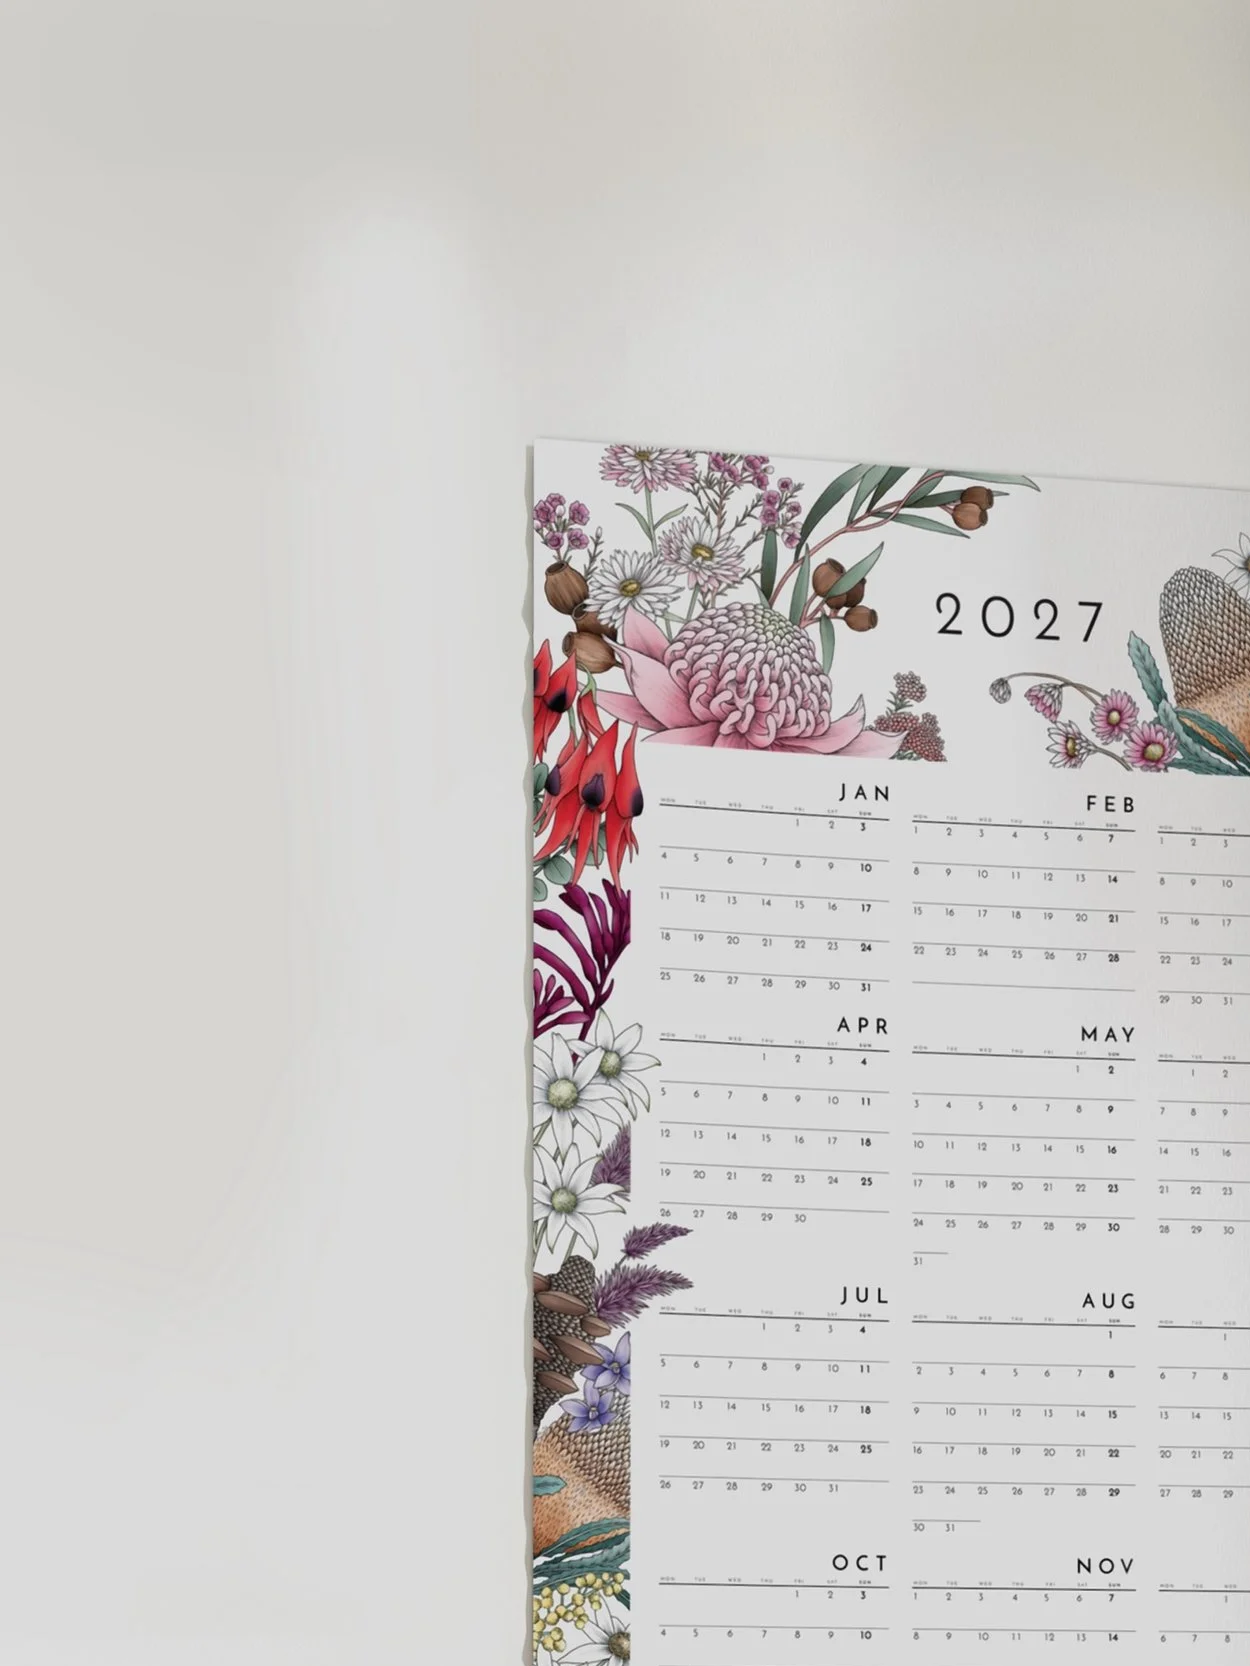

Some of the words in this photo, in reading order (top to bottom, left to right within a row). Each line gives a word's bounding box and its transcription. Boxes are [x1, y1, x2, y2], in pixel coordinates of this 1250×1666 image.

[934, 591, 1104, 644] 2027
[838, 782, 889, 802] JAN
[1086, 794, 1135, 814] FEB
[860, 862, 873, 873] 10
[1107, 874, 1119, 884] 14
[1221, 879, 1234, 889] 10
[660, 891, 670, 901] 11
[695, 893, 706, 904] 12
[727, 895, 738, 906] 13
[761, 898, 772, 907] 14
[794, 899, 805, 910] 15
[827, 901, 838, 912] 16
[860, 902, 872, 913] 17
[913, 905, 923, 916] 15
[945, 907, 956, 917] 16
[977, 908, 988, 918] 17
[1011, 910, 1022, 920] 18
[1043, 911, 1054, 921] 19
[1075, 912, 1089, 923] 20
[1107, 913, 1120, 924] 21
[859, 942, 873, 953] 24
[1107, 952, 1121, 964] 28
[860, 982, 872, 993] 31
[1158, 994, 1171, 1005] 29
[836, 1016, 888, 1035] APR
[1081, 1025, 1135, 1043] MAY
[860, 1096, 871, 1107] 11
[860, 1136, 872, 1148] 18
[913, 1139, 925, 1150] 10
[945, 1140, 955, 1150] 11
[977, 1141, 988, 1152] 12
[1011, 1142, 1022, 1153] 13
[1043, 1143, 1053, 1153] 14
[1075, 1144, 1085, 1154] 15
[1107, 1144, 1118, 1155] 16
[1159, 1146, 1169, 1155] 14
[1190, 1147, 1200, 1157] 15
[1222, 1148, 1232, 1158] 16
[660, 1167, 672, 1177] 19
[692, 1169, 707, 1180] 20
[726, 1170, 737, 1181] 21
[760, 1172, 773, 1183] 22
[793, 1174, 806, 1184] 23
[827, 1175, 839, 1185] 24
[860, 1176, 874, 1187] 25
[1107, 1183, 1120, 1194] 23
[794, 1213, 807, 1224] 30
[1107, 1222, 1121, 1233] 30
[1223, 1225, 1235, 1236] 30
[913, 1256, 923, 1266] 31
[839, 1286, 889, 1306] JUL
[1081, 1292, 1135, 1310] AUG
[859, 1363, 871, 1374] 11
[860, 1404, 872, 1415] 18
[945, 1406, 957, 1417] 10
[978, 1407, 988, 1417] 11
[1011, 1407, 1022, 1418] 12
[1043, 1408, 1054, 1419] 13
[1076, 1409, 1086, 1418] 14
[1107, 1409, 1118, 1420] 15
[1159, 1410, 1170, 1421] 13
[1191, 1411, 1202, 1420] 14
[1222, 1411, 1232, 1421] 15
[659, 1438, 671, 1449] 19
[692, 1439, 706, 1450] 20
[725, 1440, 737, 1451] 21
[760, 1441, 773, 1452] 22
[793, 1442, 806, 1453] 23
[827, 1443, 840, 1454] 24
[859, 1443, 873, 1455] 25
[1107, 1447, 1121, 1459] 22
[828, 1483, 839, 1493] 31
[1107, 1487, 1121, 1498] 29
[913, 1522, 926, 1533] 30
[945, 1522, 955, 1533] 31
[831, 1553, 887, 1572] OCT
[1076, 1557, 1134, 1575] NOV
[859, 1629, 873, 1641] 10
[978, 1631, 990, 1642] 10
[1011, 1632, 1021, 1641] 11
[1044, 1632, 1056, 1642] 12
[1076, 1632, 1087, 1643] 13
[1107, 1632, 1119, 1643] 14
